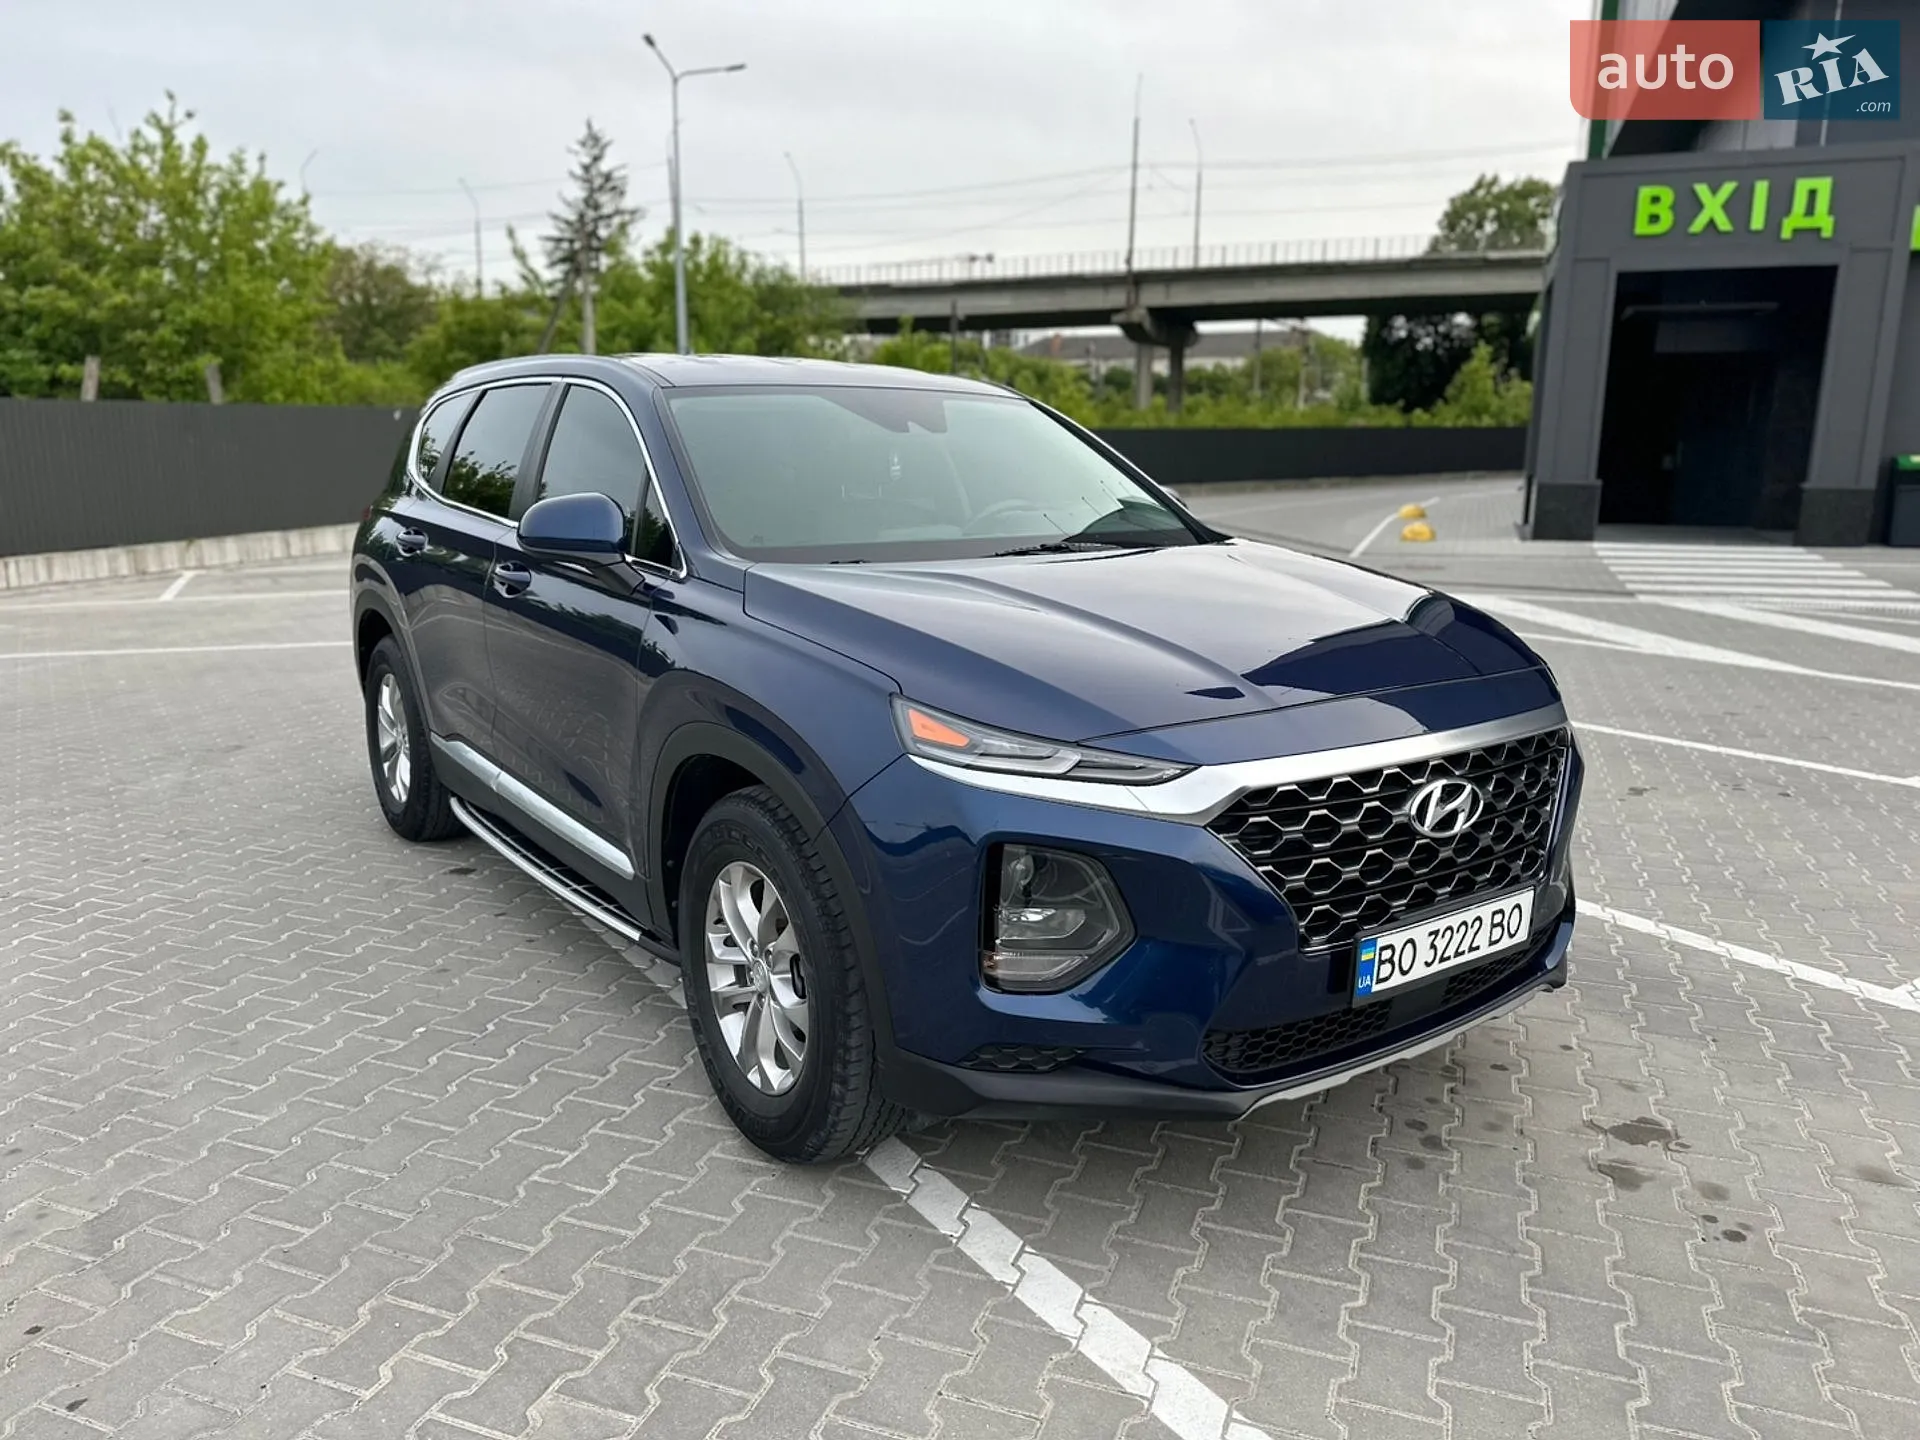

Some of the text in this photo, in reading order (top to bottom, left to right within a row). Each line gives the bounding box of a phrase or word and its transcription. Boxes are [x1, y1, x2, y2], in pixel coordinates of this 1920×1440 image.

[1633, 176, 1836, 240] ВХІД
[1374, 903, 1523, 985] BO 3222 BO
[1358, 975, 1371, 989] UA
